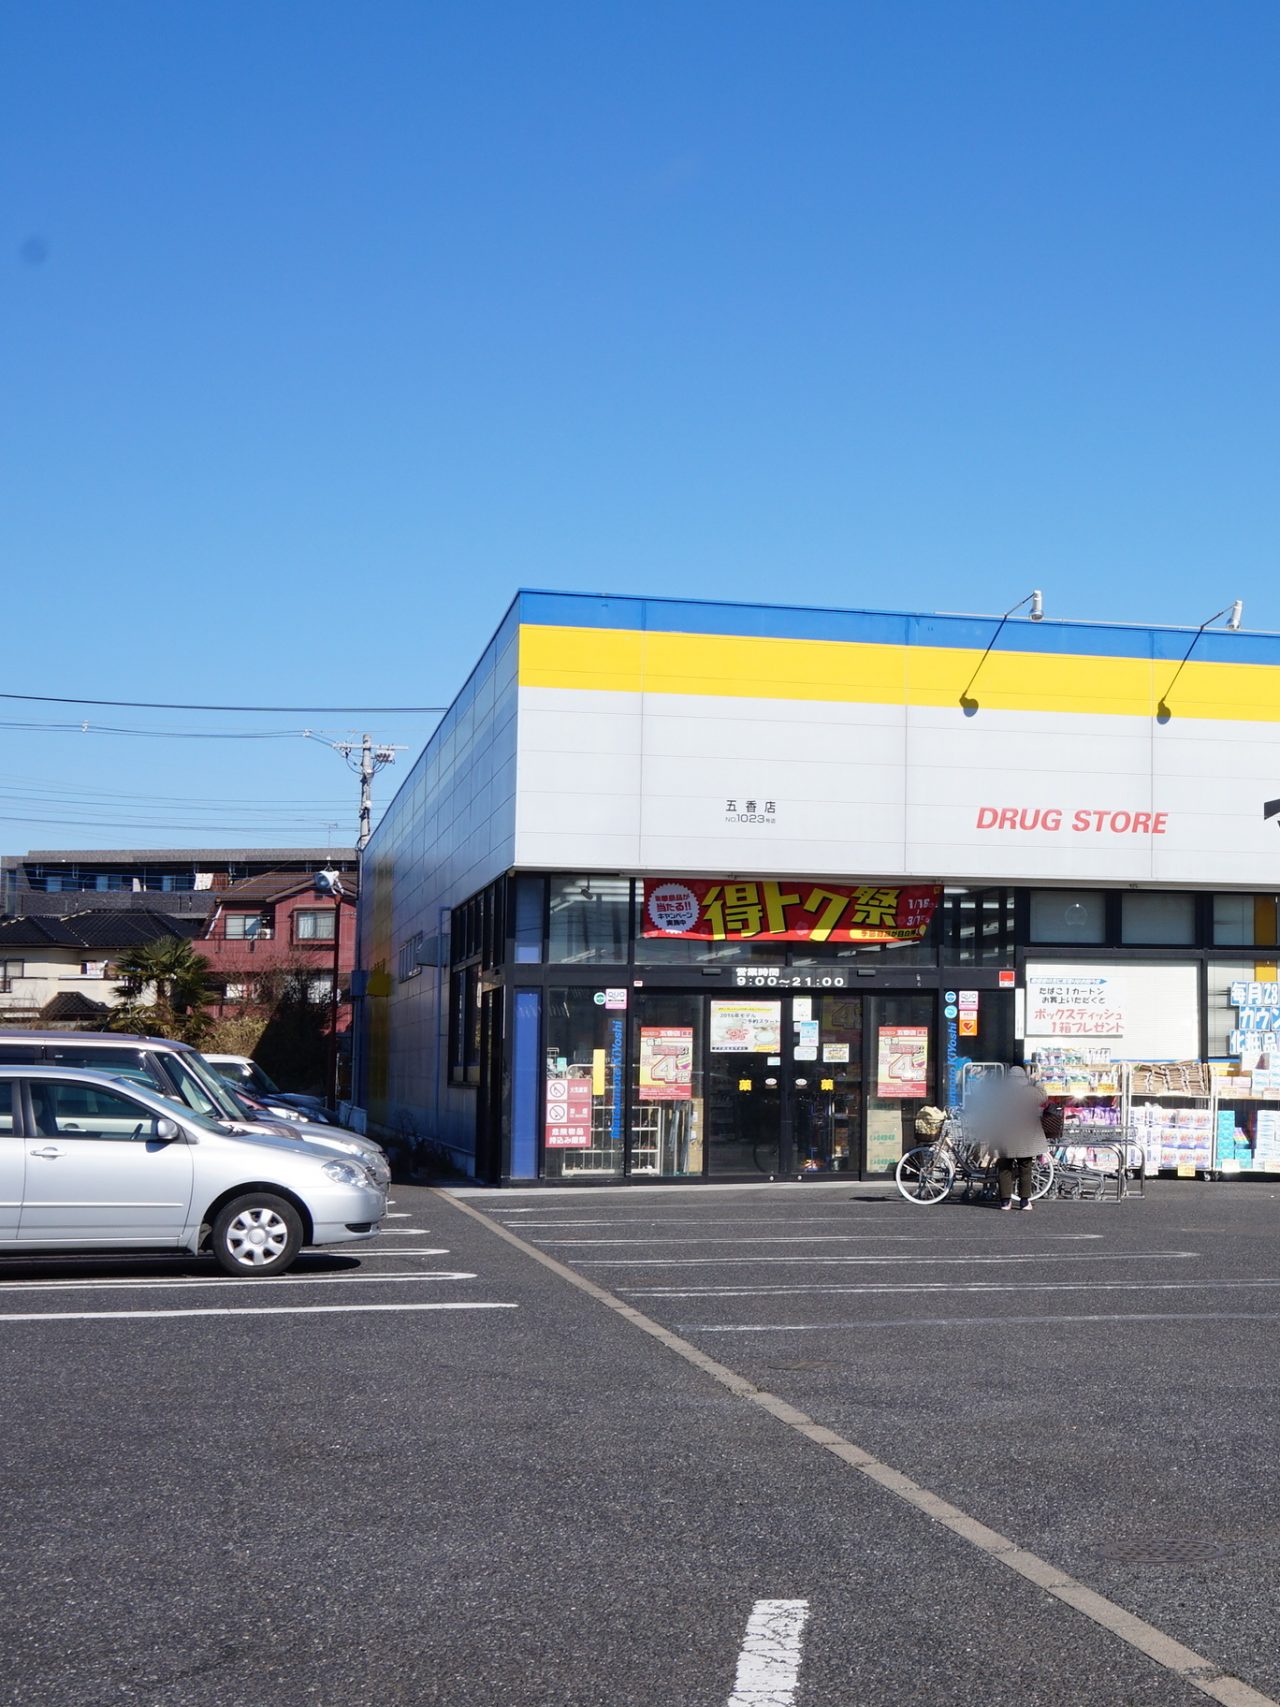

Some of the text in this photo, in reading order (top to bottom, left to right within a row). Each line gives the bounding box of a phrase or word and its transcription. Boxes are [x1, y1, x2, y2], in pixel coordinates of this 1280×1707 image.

[726, 800, 776, 813] 五香店
[976, 807, 1169, 834] DRUG STORE
[701, 881, 902, 941] 得トク祭
[736, 967, 780, 977] 営業時間
[611, 1020, 623, 1066] KiYoshi
[947, 1021, 957, 1065] KiYoshi
